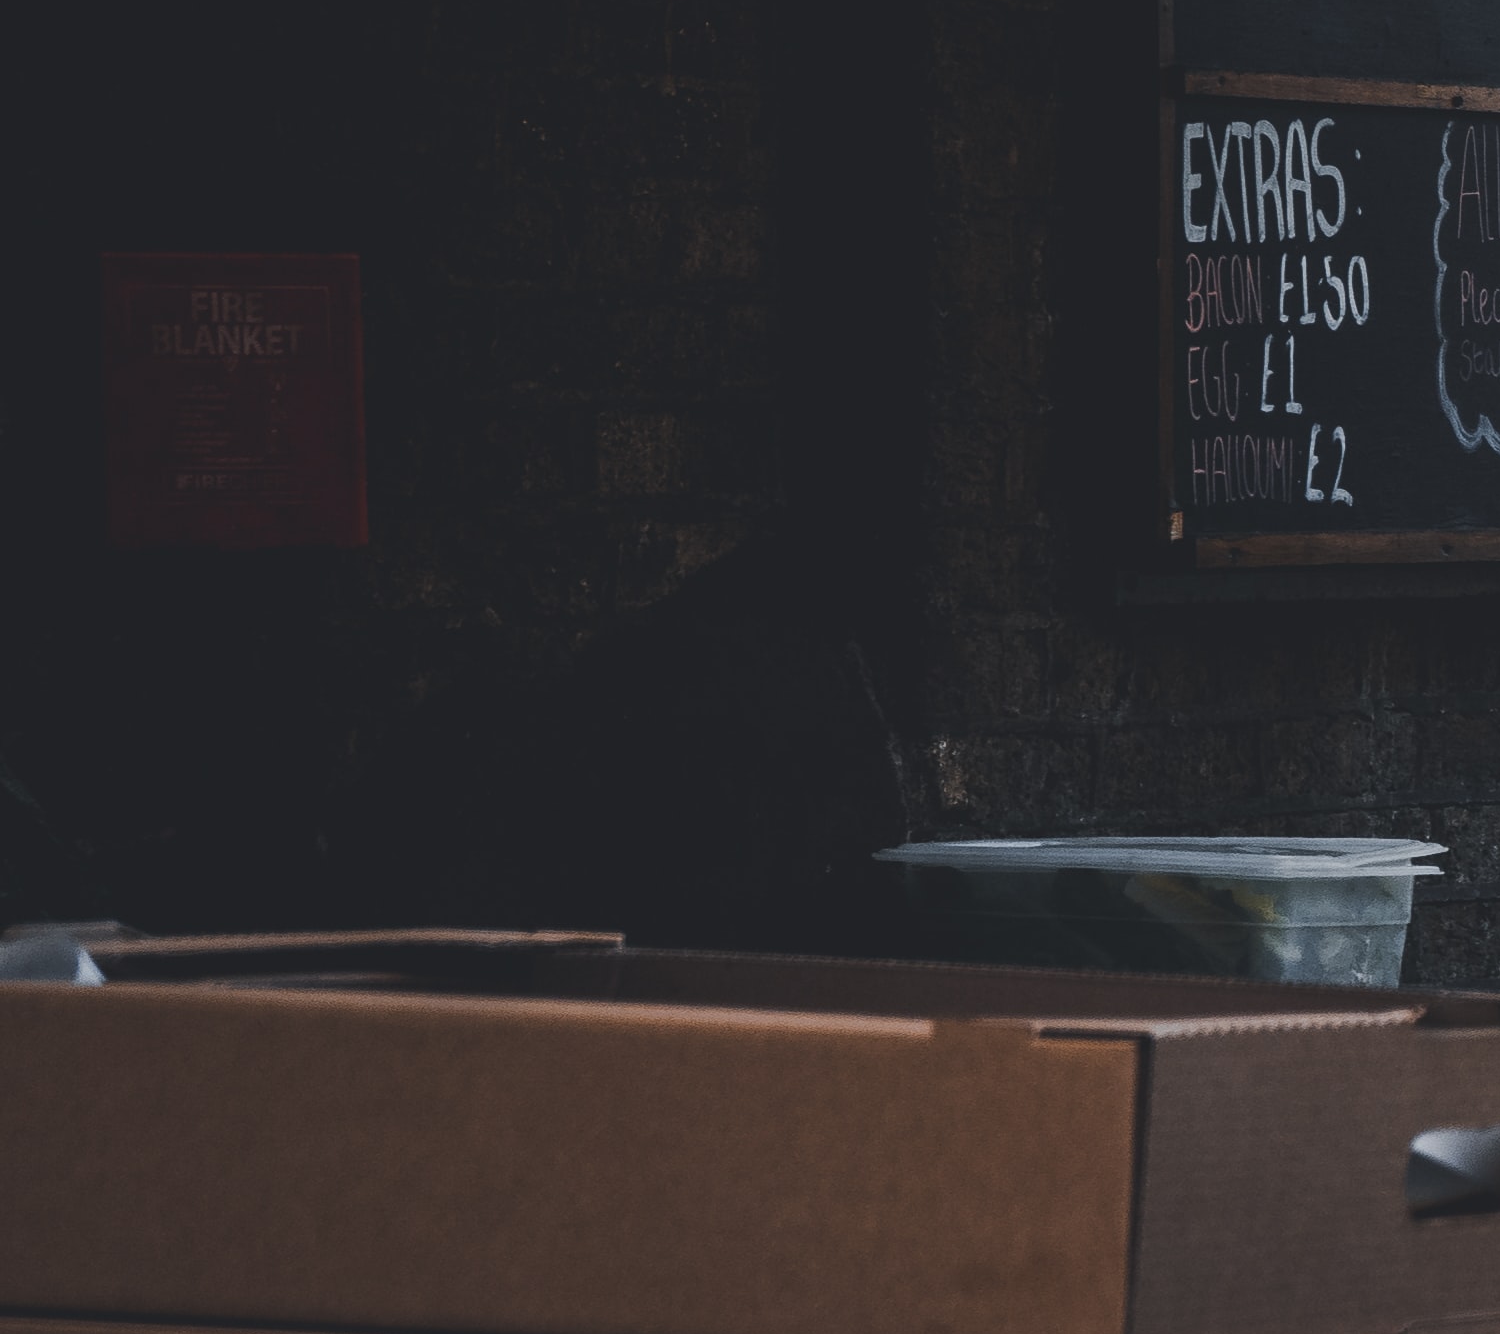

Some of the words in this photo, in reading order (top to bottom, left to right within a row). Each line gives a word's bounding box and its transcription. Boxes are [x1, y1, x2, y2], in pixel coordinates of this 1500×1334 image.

[191, 291, 264, 323] FIRE
[152, 323, 304, 356] BLANKET
[1259, 332, 1303, 414] £1
[1304, 423, 1355, 507] £2
